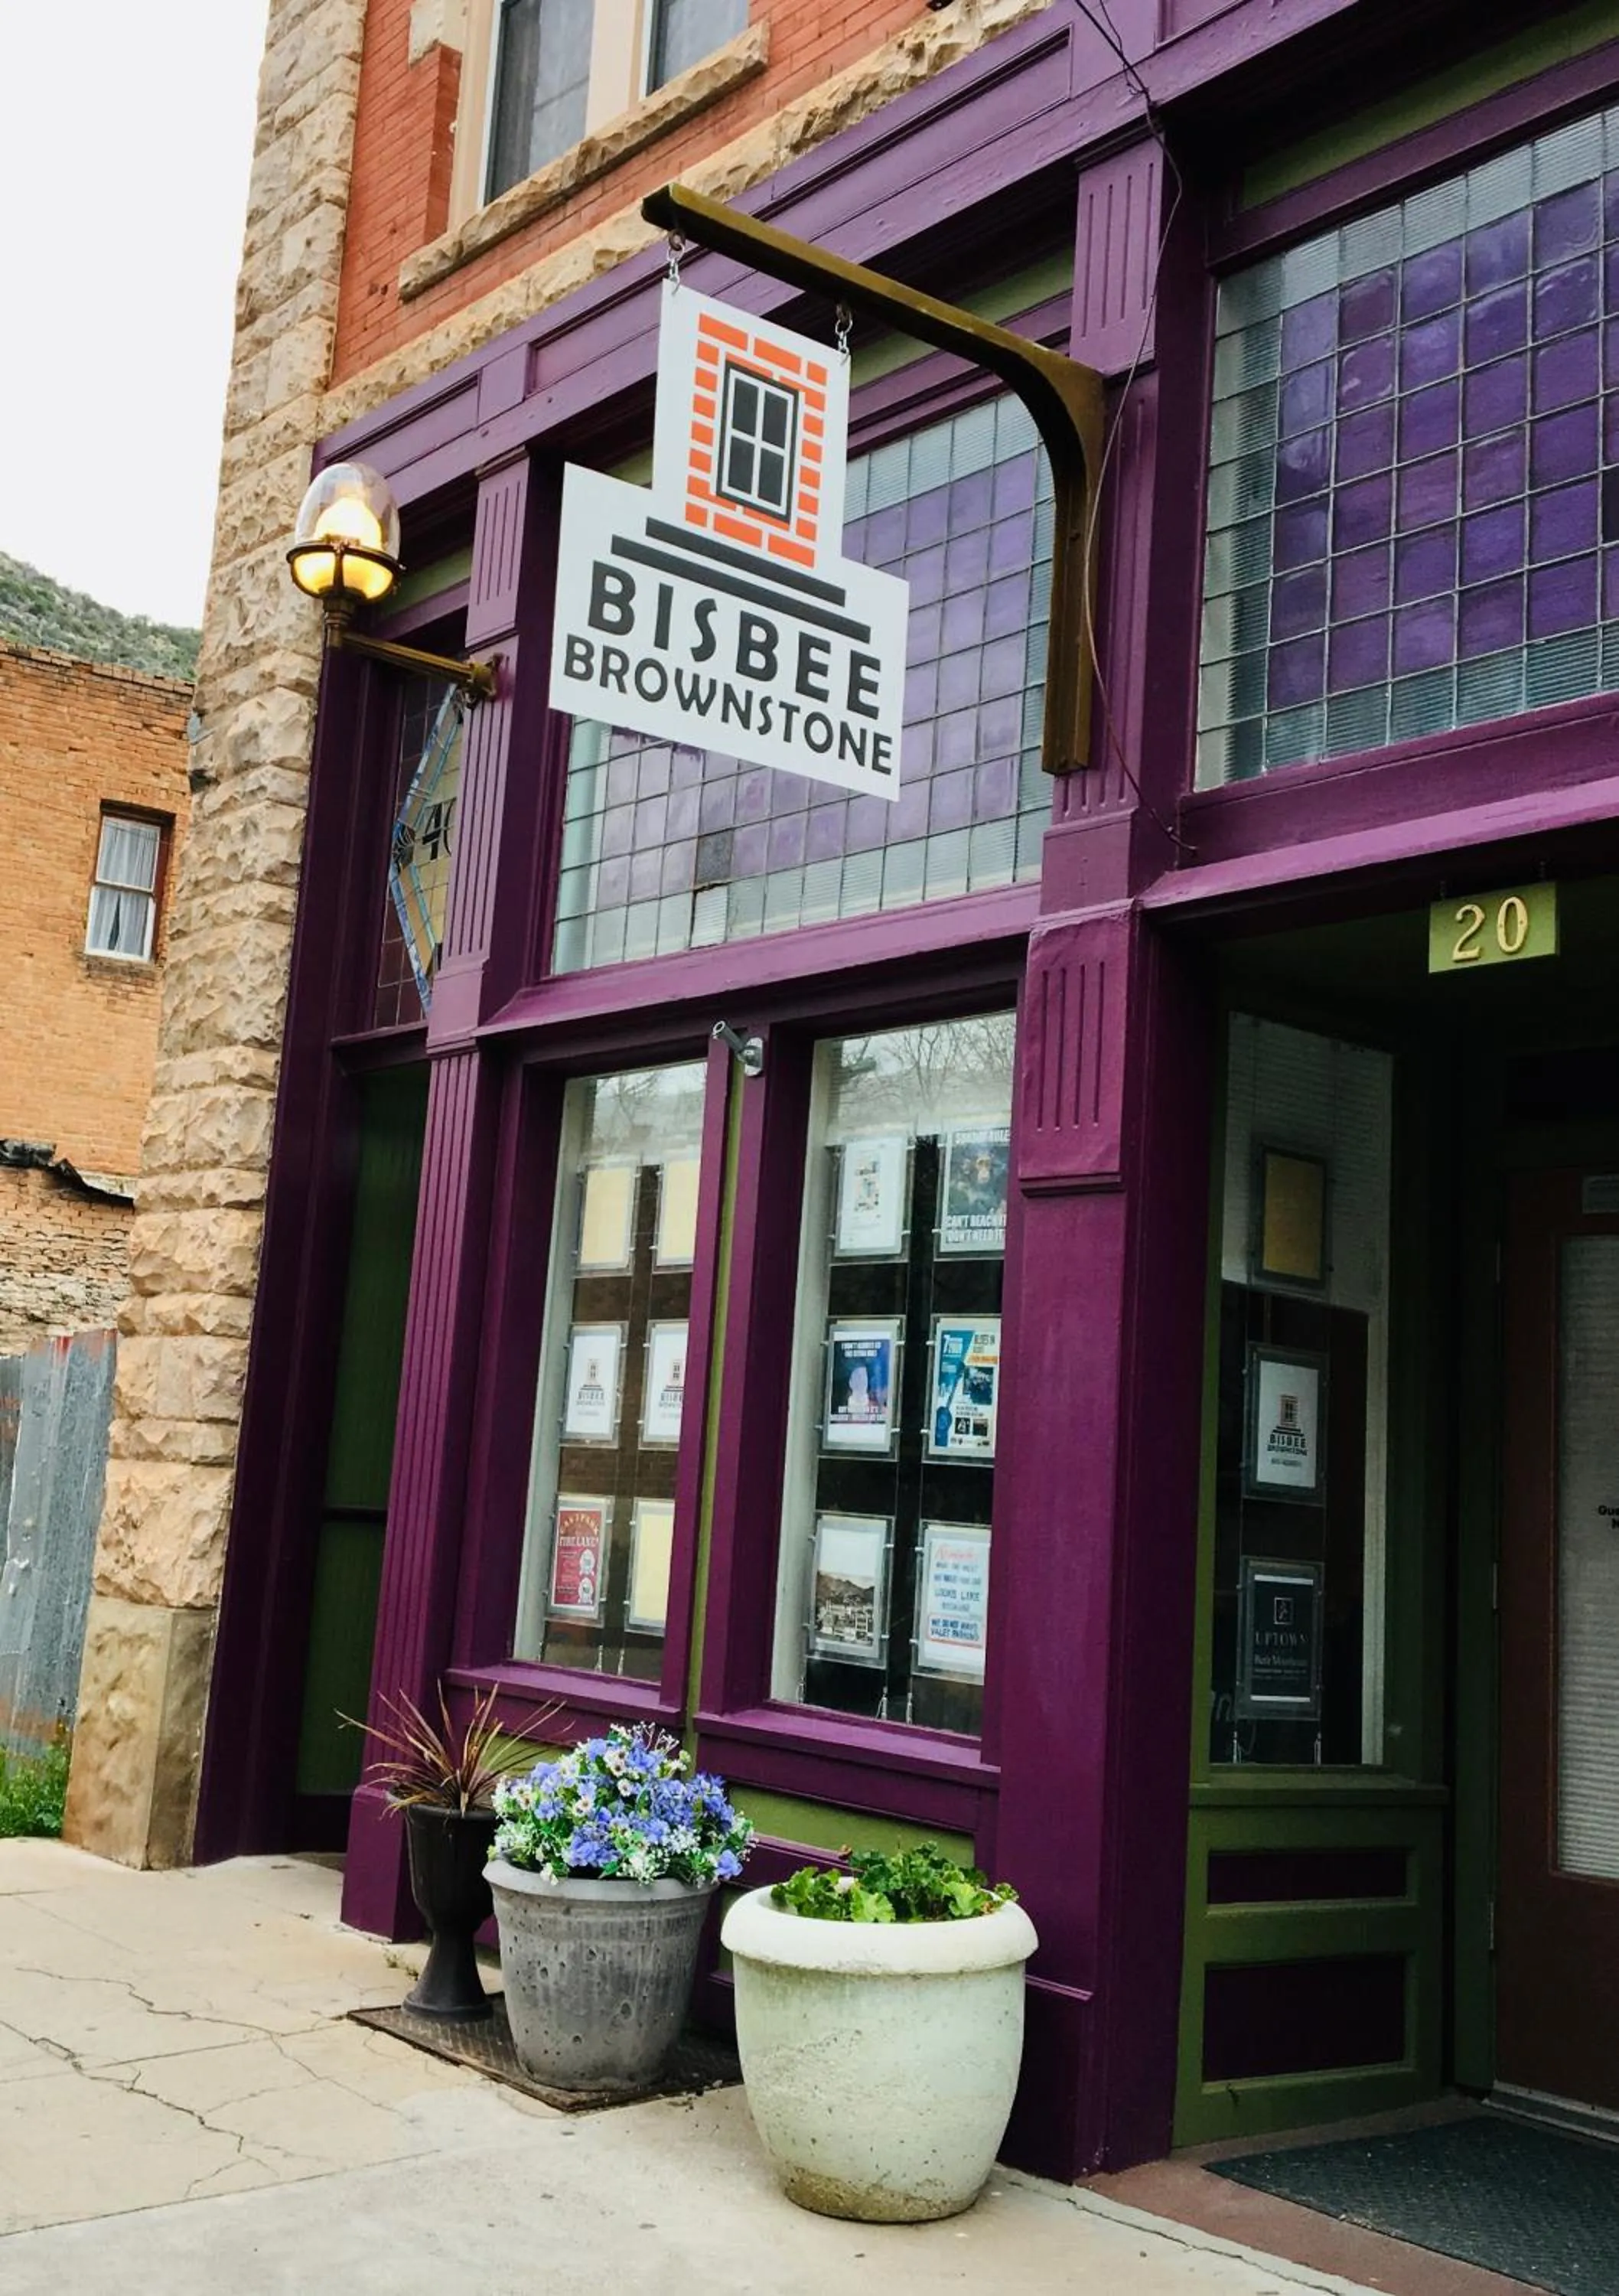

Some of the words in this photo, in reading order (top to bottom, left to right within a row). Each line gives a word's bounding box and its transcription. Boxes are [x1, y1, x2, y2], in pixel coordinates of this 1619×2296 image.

[564, 633, 893, 775] BROWNSTONE
[588, 560, 881, 720] BISBEE
[1452, 896, 1528, 960] 20
